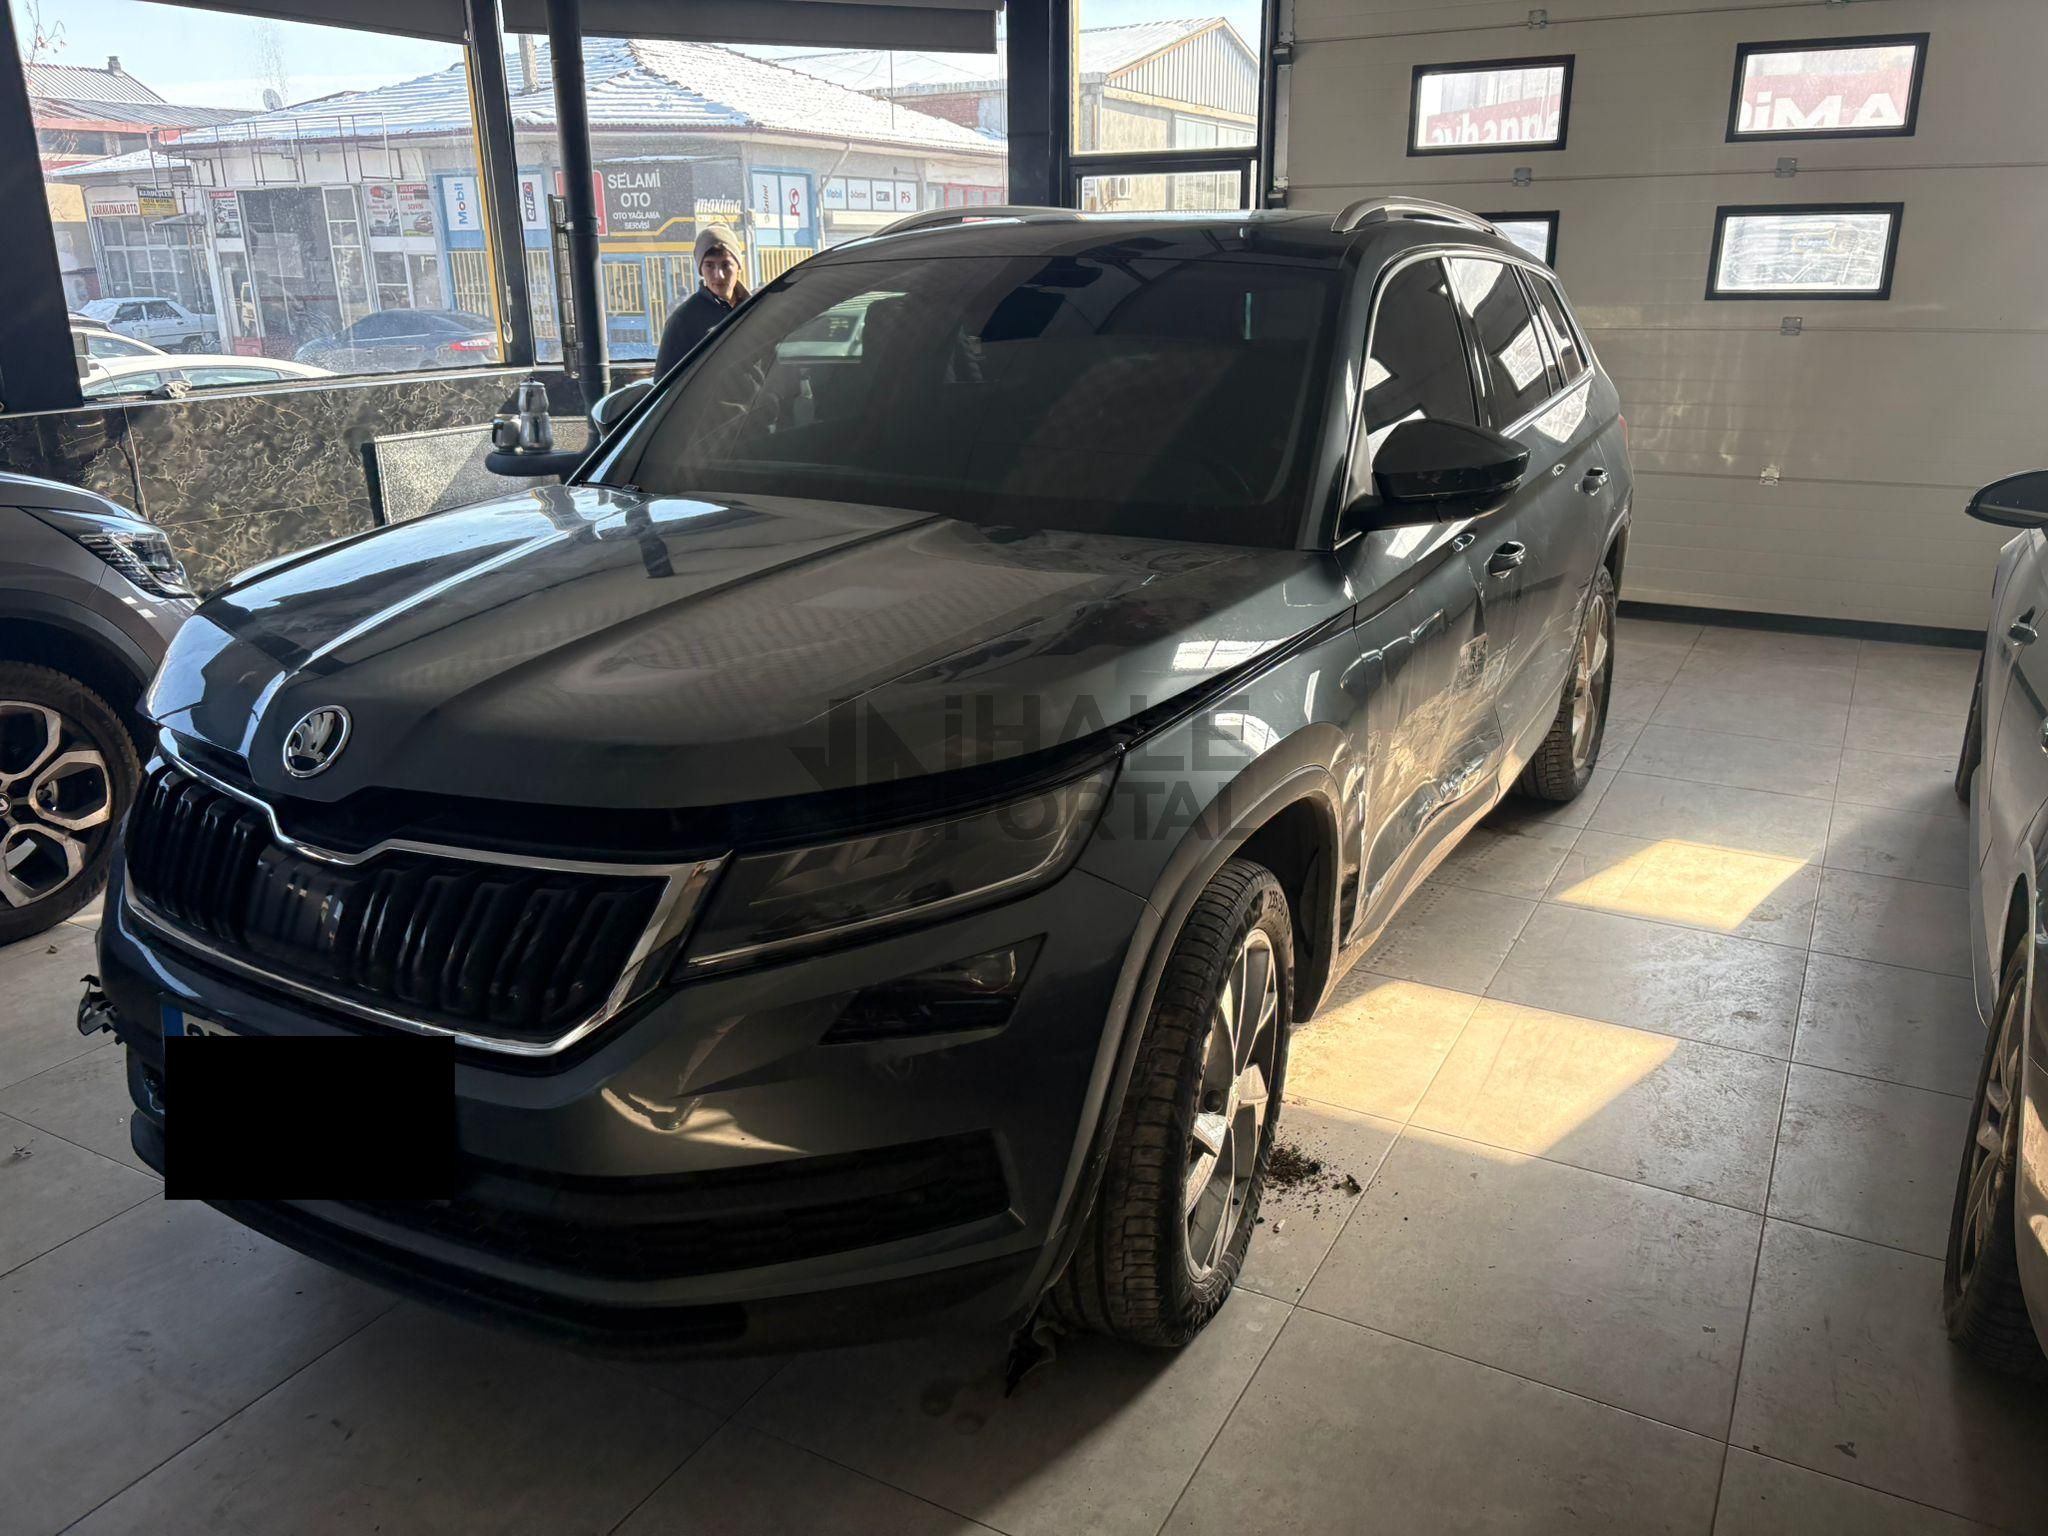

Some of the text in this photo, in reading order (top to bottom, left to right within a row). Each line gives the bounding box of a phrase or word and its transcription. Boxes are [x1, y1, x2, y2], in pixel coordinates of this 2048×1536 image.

[607, 169, 660, 189] SELAMİ
[454, 183, 468, 225] Mobil
[620, 192, 651, 207] OTO
[612, 211, 660, 220] OTO YAĞLAMA
